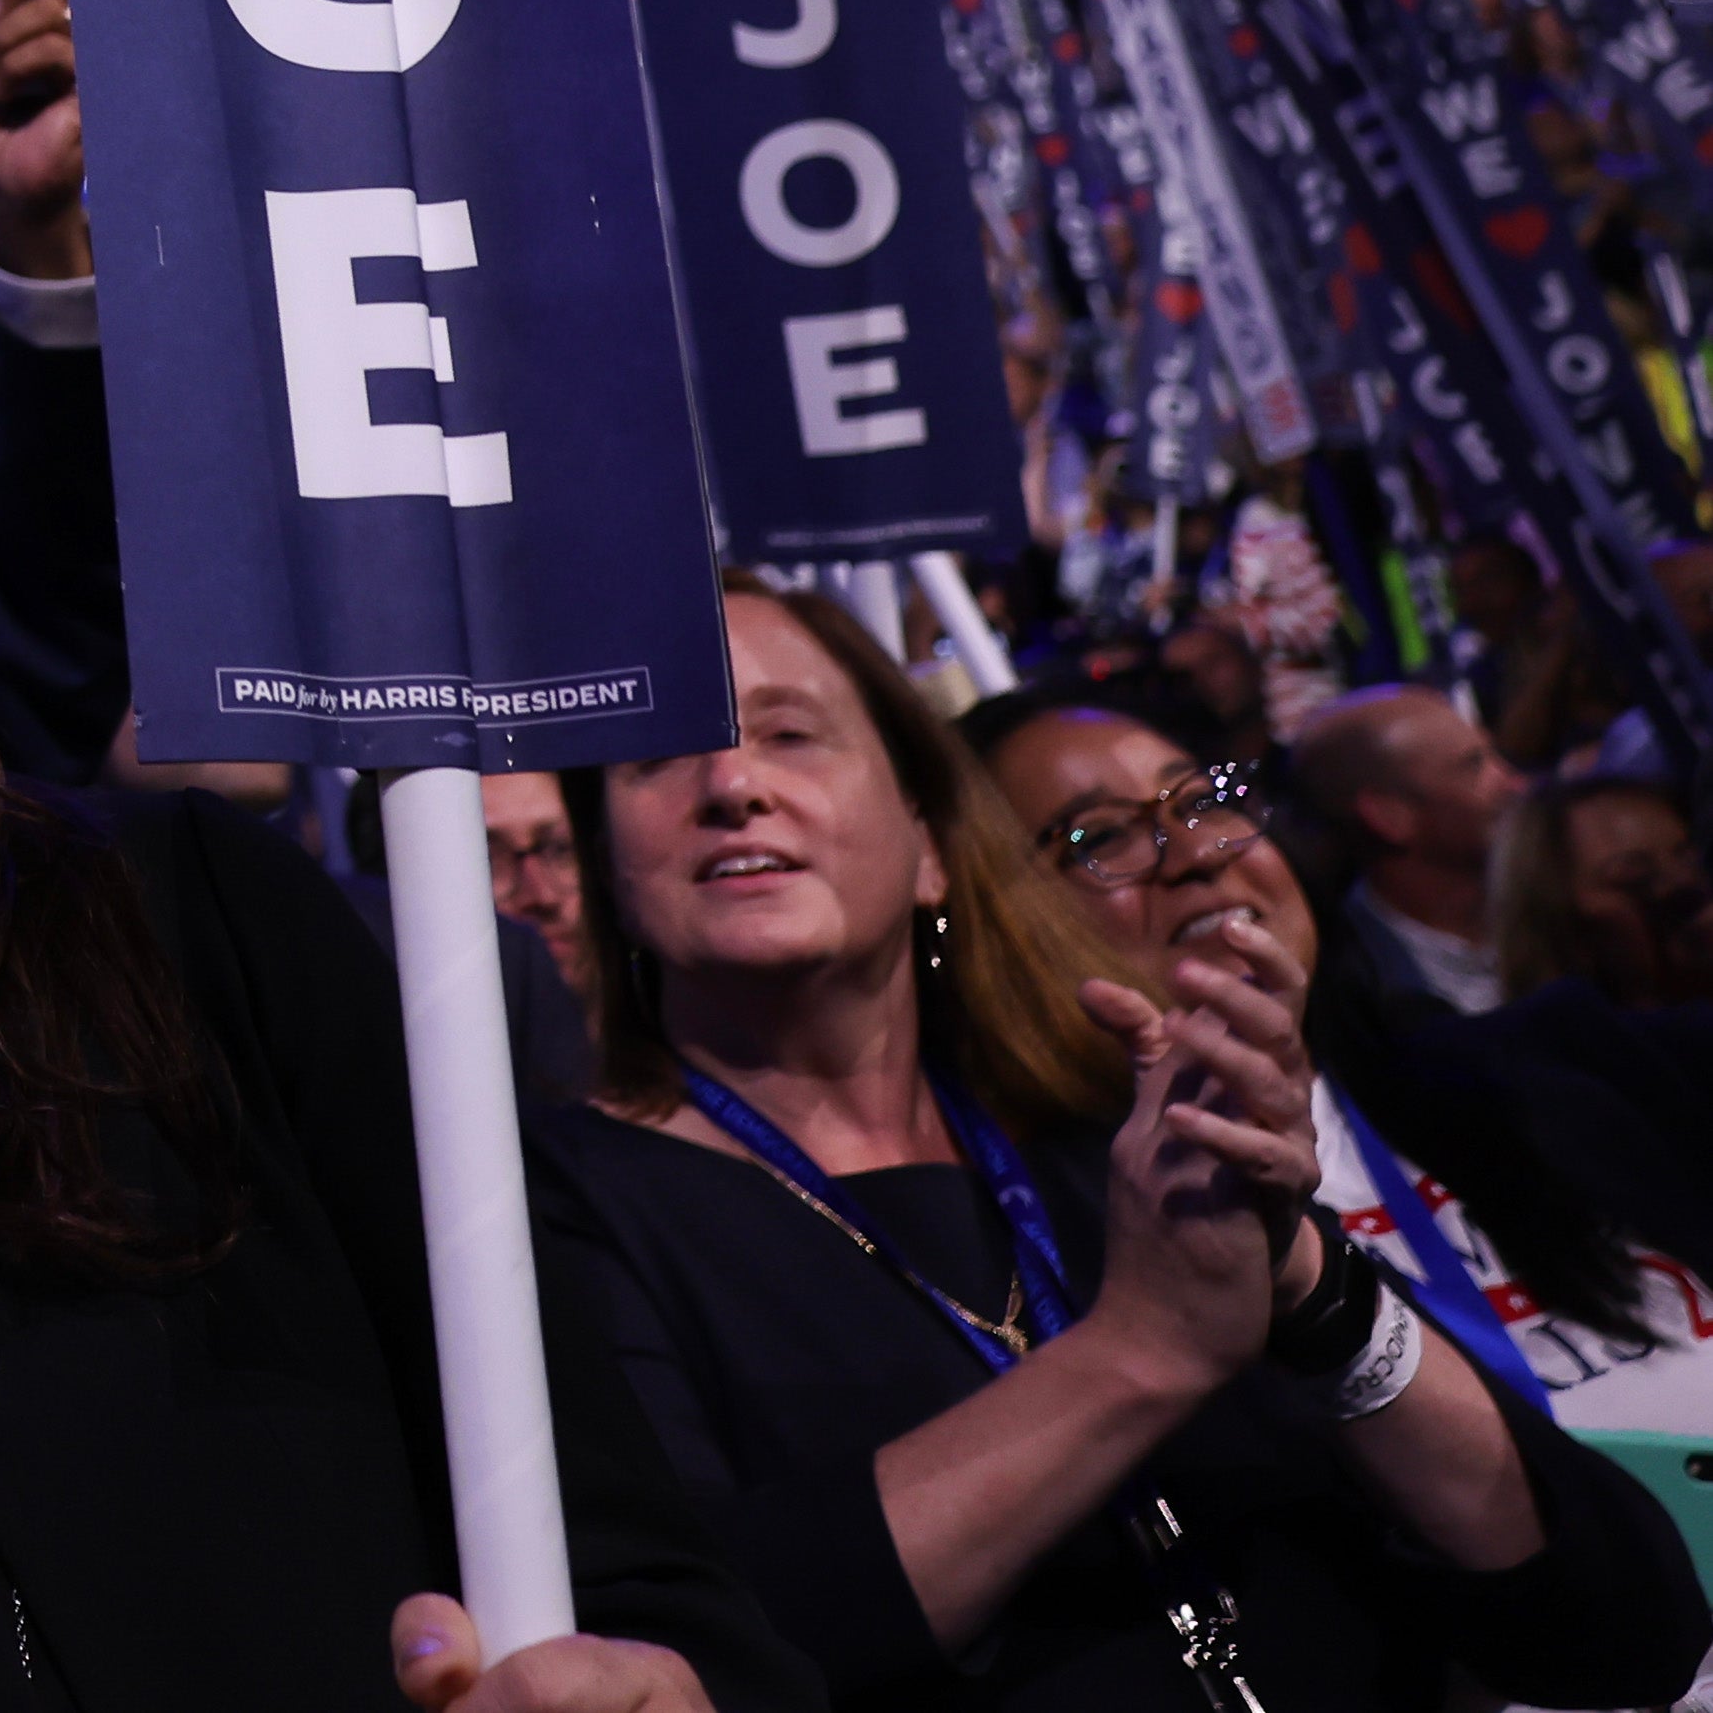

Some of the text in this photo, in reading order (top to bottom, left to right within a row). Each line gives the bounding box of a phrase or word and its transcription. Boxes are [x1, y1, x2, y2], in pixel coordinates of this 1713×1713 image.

[233, 677, 297, 702] PAID
[339, 684, 458, 711] HARRIS
[472, 678, 639, 717] PRESIDENT
